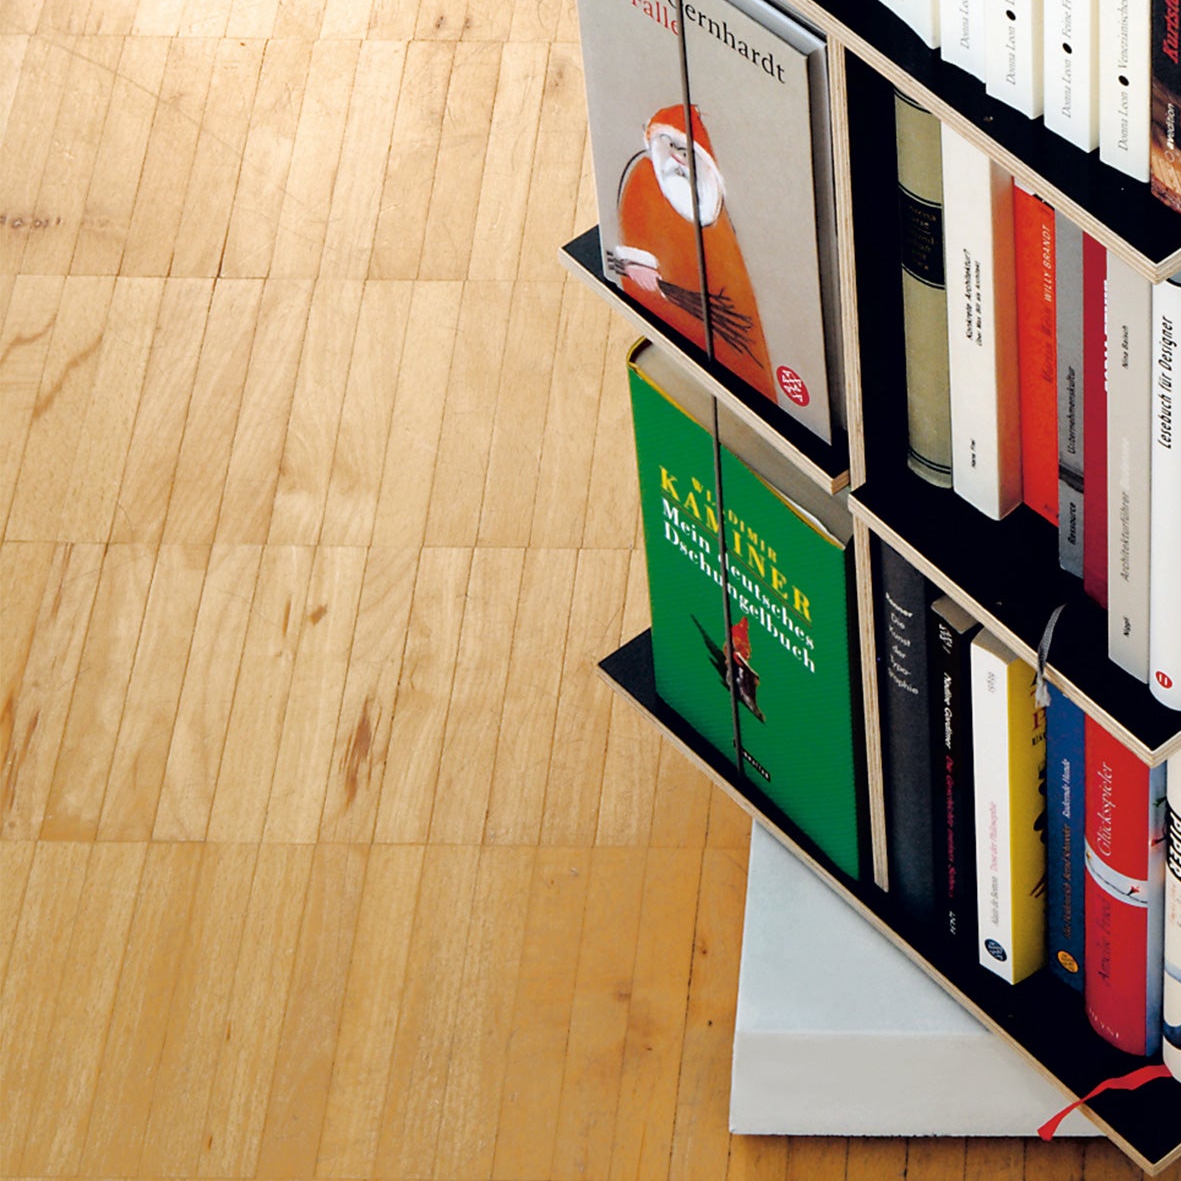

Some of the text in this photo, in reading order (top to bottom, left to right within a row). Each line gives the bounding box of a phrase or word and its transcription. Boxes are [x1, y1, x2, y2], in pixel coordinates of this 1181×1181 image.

[1061, 58, 1072, 83] Leon
[1061, 84, 1073, 119] Donna
[1117, 91, 1129, 116] Leon
[1117, 117, 1130, 152] Donna
[1041, 224, 1053, 302] WILLY BRANDT
[1157, 315, 1178, 450] Lesebuch für Designer
[659, 464, 812, 622] KAMINER
[691, 477, 778, 563] WLDIMIR
[661, 497, 815, 651] Mein deutsches
[663, 519, 816, 674] Dschungelbuch
